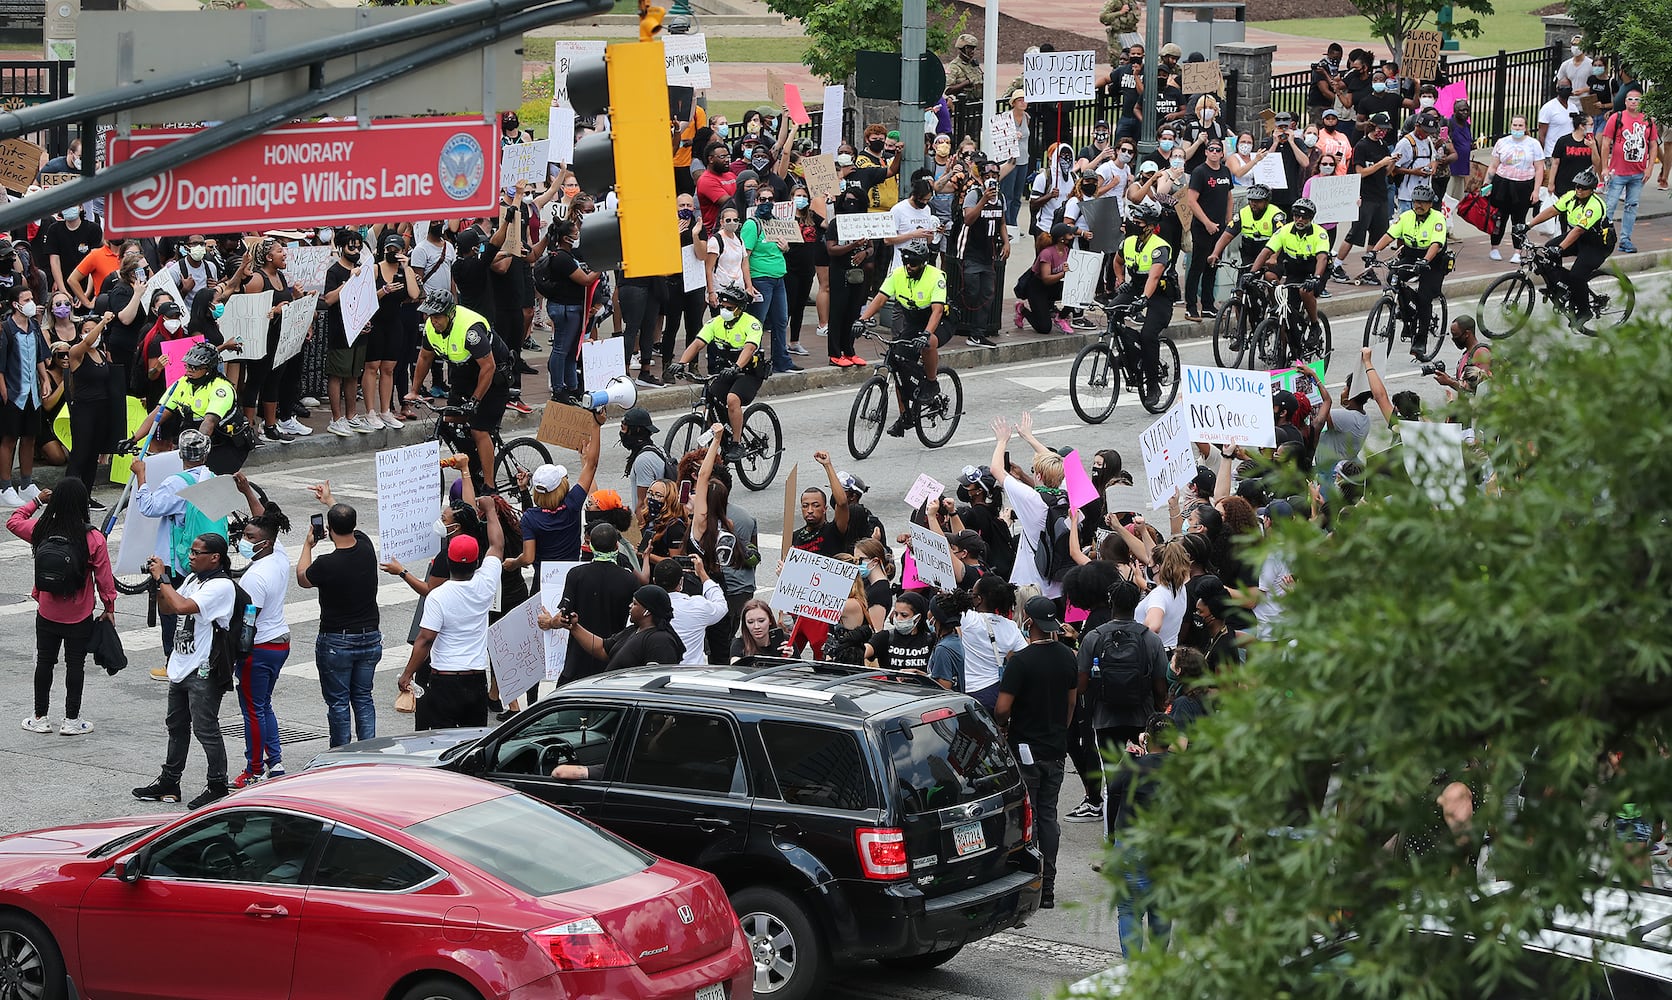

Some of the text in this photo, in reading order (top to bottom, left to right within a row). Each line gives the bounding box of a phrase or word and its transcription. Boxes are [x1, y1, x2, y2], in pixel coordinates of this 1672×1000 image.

[1407, 31, 1438, 42] BLACK
[1405, 42, 1438, 59] LIVES
[1025, 54, 1094, 72] NO JUSTICE
[1401, 58, 1436, 79] MATTER
[1024, 75, 1093, 96] NO PEACE
[0, 145, 27, 159] ite
[264, 141, 354, 165] HONORARY
[508, 146, 541, 159] BLACK
[512, 158, 536, 170] LIVES
[503, 169, 544, 185] MATTER
[176, 167, 434, 213] Dominique Wilkins Lane
[988, 219, 996, 236] 11
[1187, 368, 1215, 394] NO
[1190, 403, 1260, 430] NO Peace
[1143, 410, 1181, 463] SILENCE
[378, 448, 438, 467] HOW DARE you
[380, 466, 405, 478] murder
[380, 481, 398, 491] black
[399, 476, 418, 489] person
[381, 524, 409, 540] #David
[413, 541, 431, 554] Floyd
[789, 550, 859, 580] WHITE SILENCE
[809, 572, 822, 587] IS
[779, 580, 848, 611] WHITE CONSENT
[890, 657, 904, 668] MY
[638, 945, 669, 958] Accord
